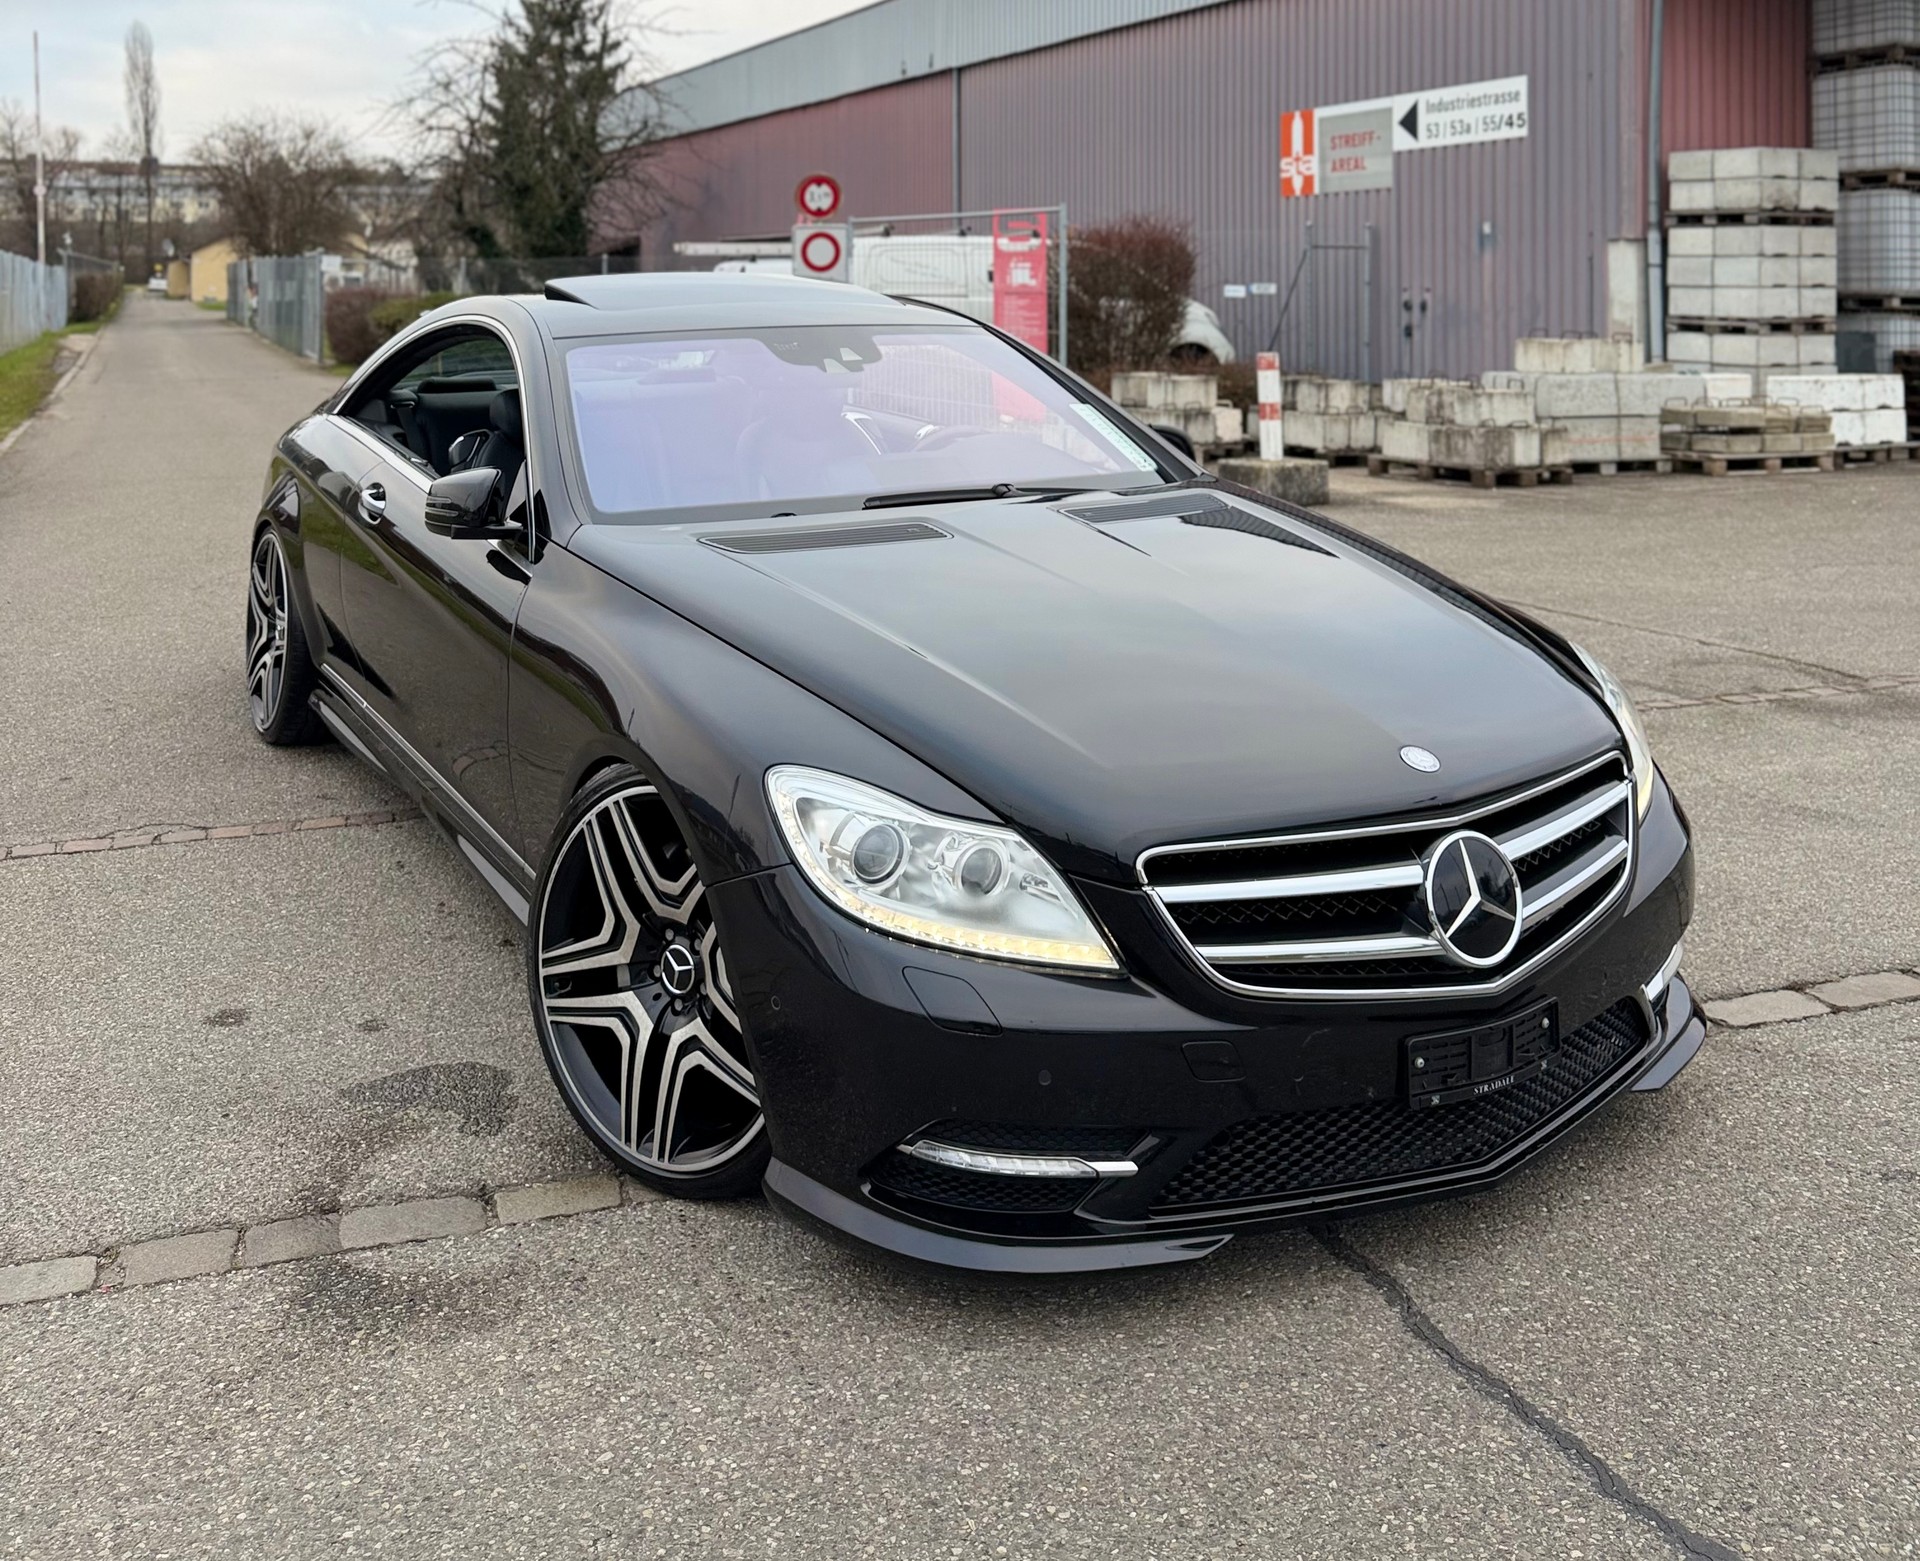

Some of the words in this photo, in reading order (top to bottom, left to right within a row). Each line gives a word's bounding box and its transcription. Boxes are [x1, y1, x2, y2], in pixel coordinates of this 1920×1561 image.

[1426, 91, 1520, 114] Industriestrasse
[1426, 122, 1440, 139] 53
[1450, 119, 1471, 136] 53a
[1482, 112, 1526, 133] 55/45
[1330, 156, 1367, 173] AREAL
